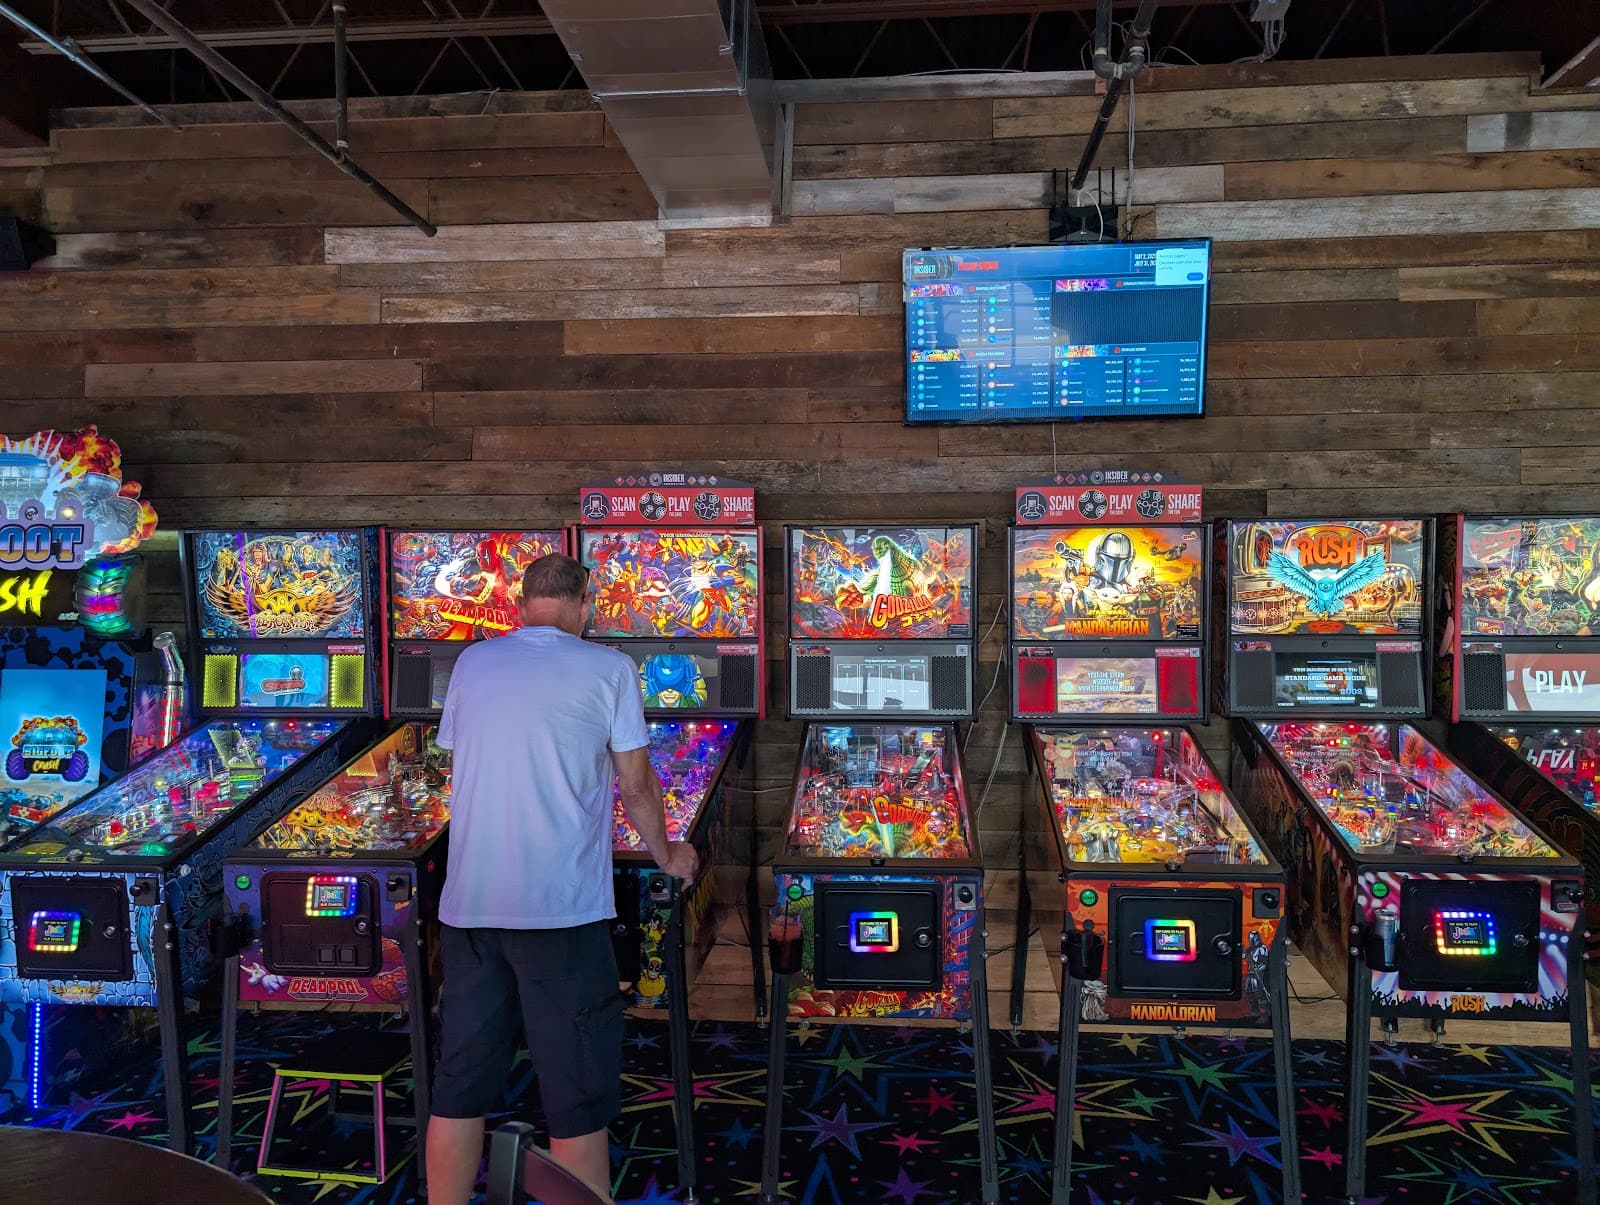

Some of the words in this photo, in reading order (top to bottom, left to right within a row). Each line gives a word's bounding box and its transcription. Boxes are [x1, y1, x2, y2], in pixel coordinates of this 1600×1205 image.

[663, 474, 685, 482] INSIDER
[1105, 471, 1128, 480] INSIDER
[612, 497, 636, 512] SCAN
[669, 497, 691, 512] PLAY
[724, 497, 753, 511] SHARE
[1049, 496, 1074, 511] SCAN
[1109, 496, 1133, 510] PLAY
[1168, 494, 1200, 509] SHARE
[1296, 535, 1357, 569] RUSH
[438, 599, 515, 630] DEADPOOL
[872, 594, 931, 629] GODZILLA
[1065, 619, 1150, 636] MANDALORIAN
[1535, 671, 1586, 694] PLAY
[23, 745, 75, 758] BIGFOOT
[32, 759, 60, 771] CRUSH
[290, 978, 369, 1001] DEADPOOL
[1131, 1005, 1216, 1021] MANDALORIAN
[1451, 995, 1486, 1014] RUSH
